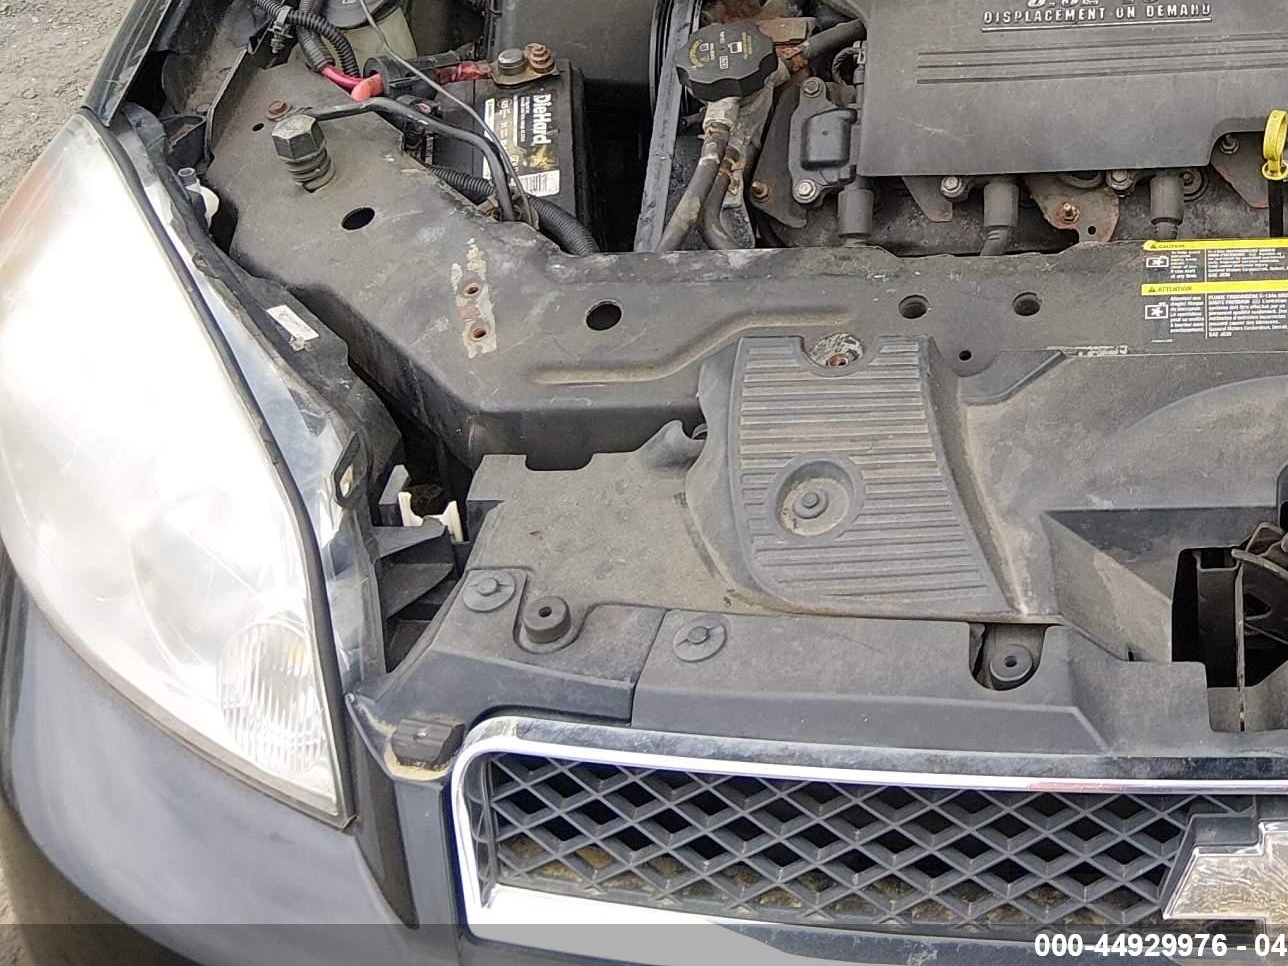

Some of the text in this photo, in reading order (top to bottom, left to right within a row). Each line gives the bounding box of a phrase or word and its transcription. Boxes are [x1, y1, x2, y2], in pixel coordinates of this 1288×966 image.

[983, 2, 1212, 24] DISPLACEMENT ON DEMAND
[533, 93, 552, 144] DieHard
